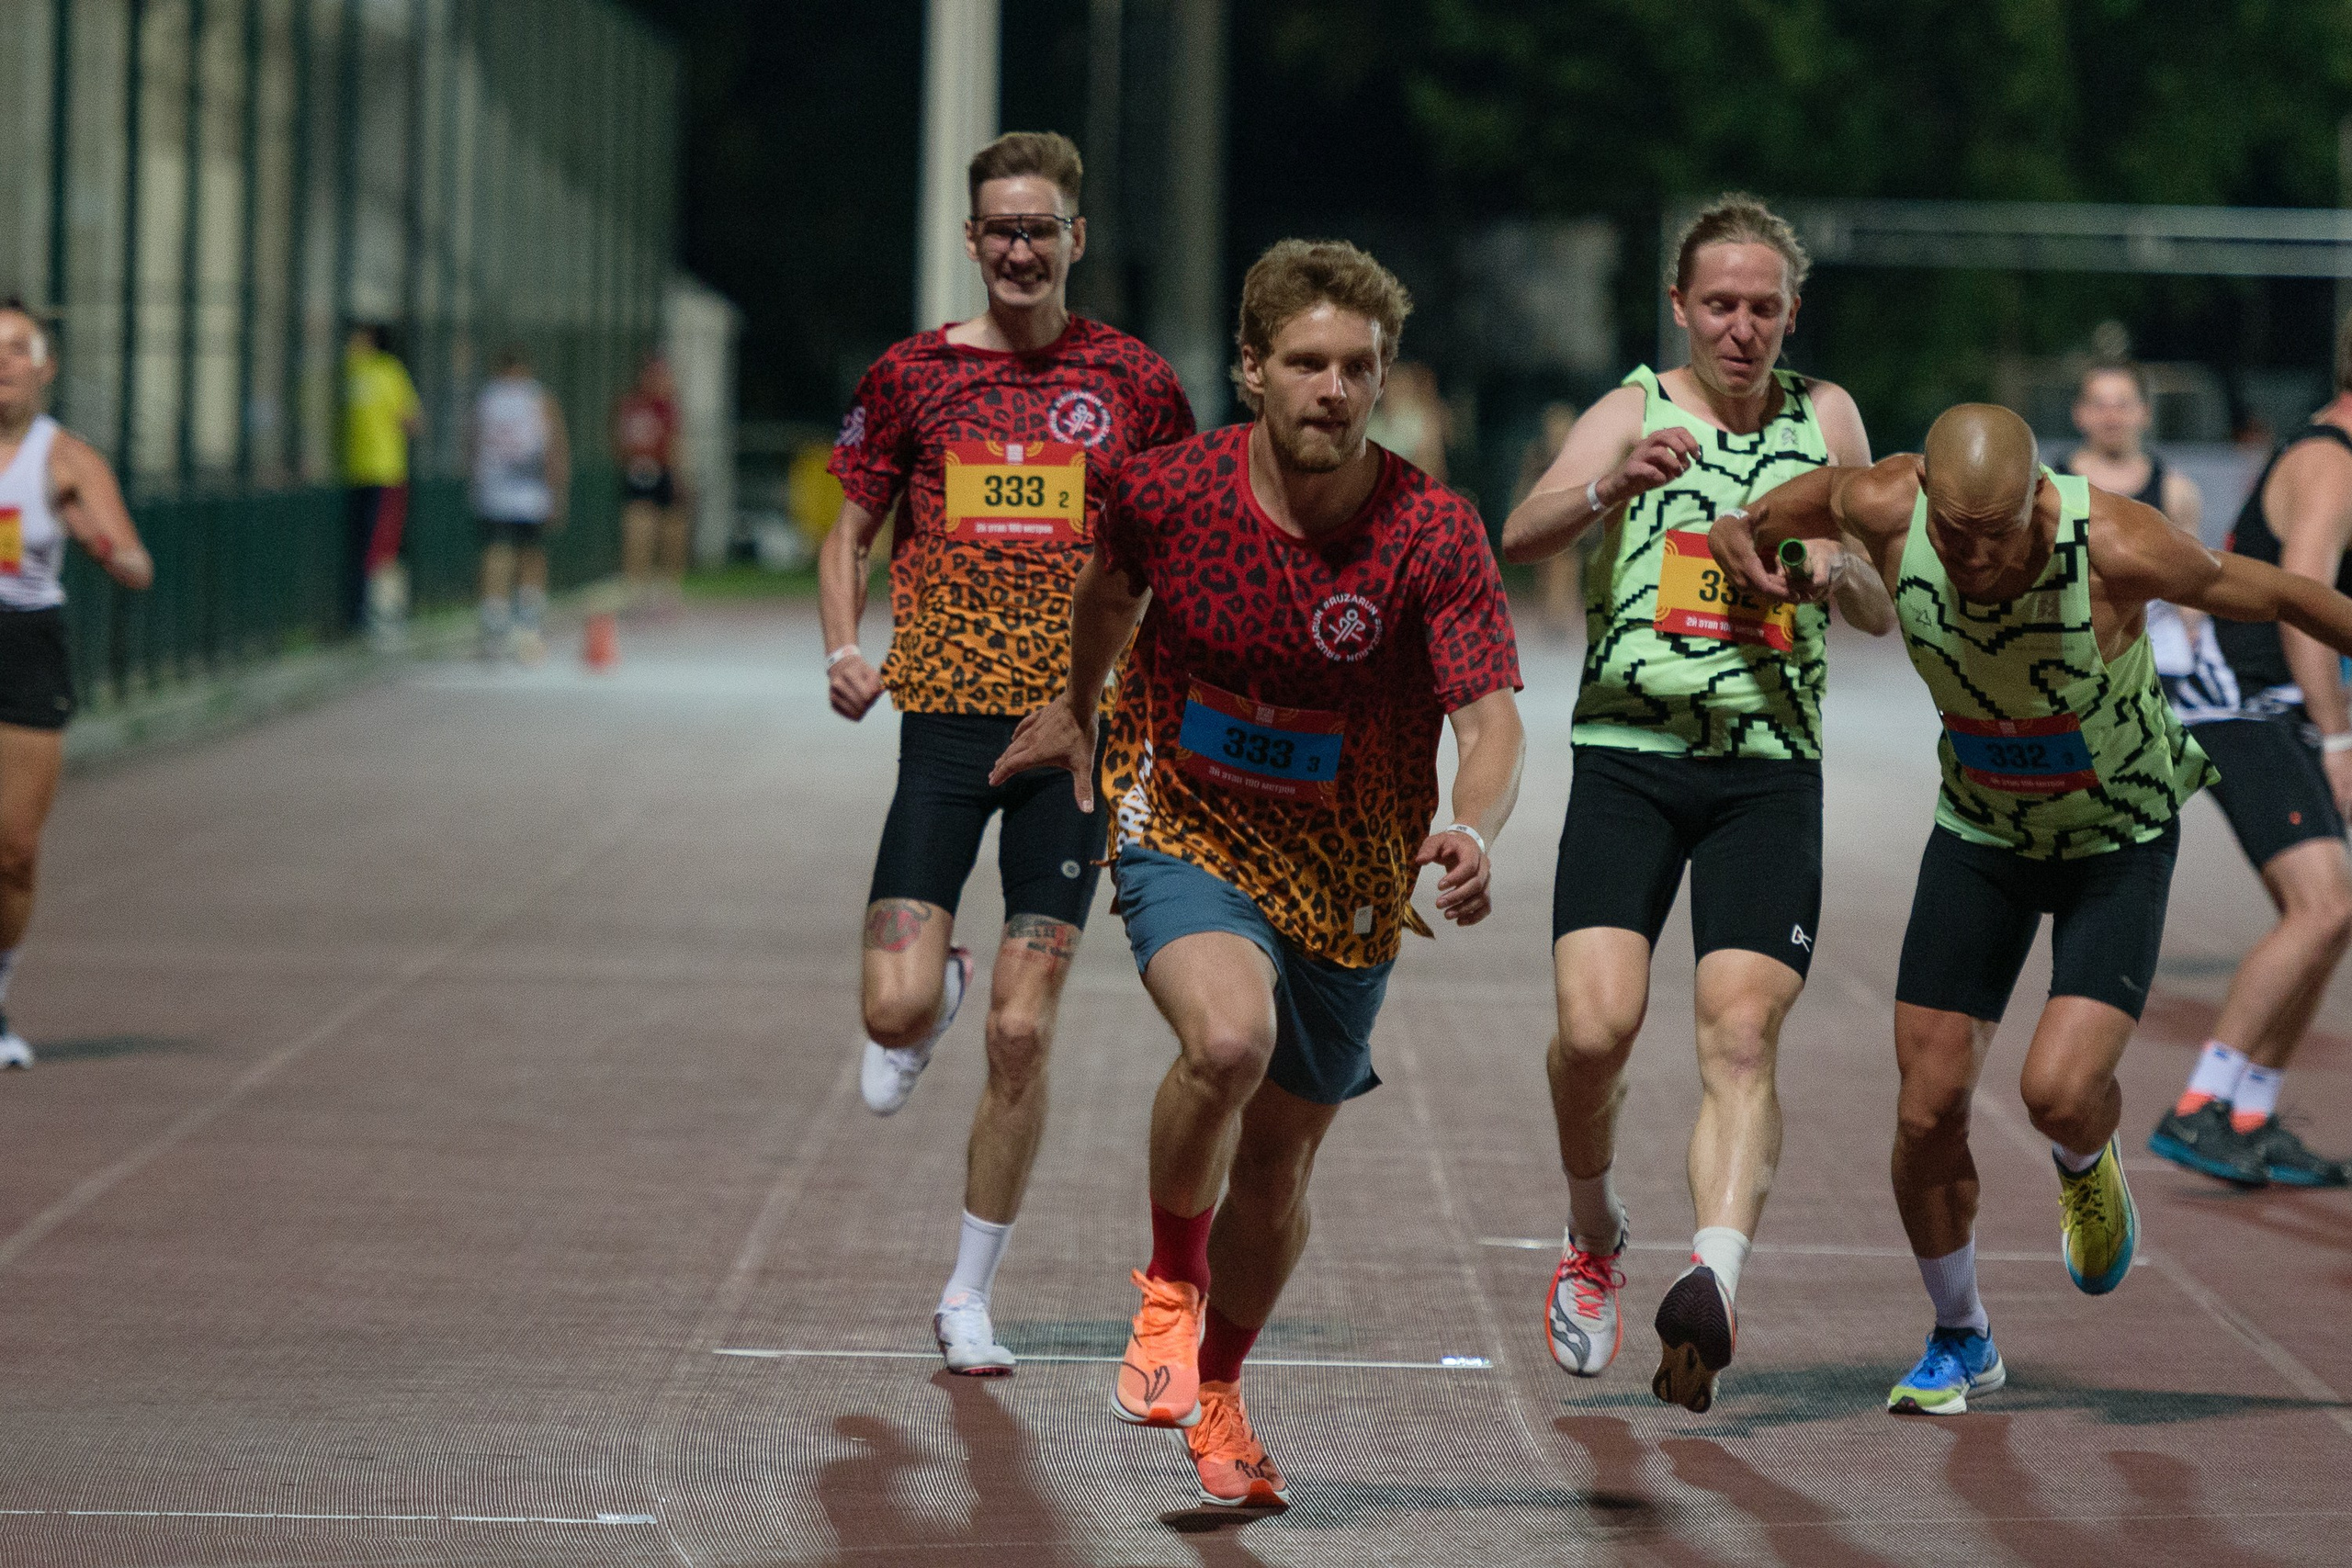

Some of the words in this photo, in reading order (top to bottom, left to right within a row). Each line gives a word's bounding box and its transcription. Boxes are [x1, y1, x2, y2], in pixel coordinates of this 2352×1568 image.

[984, 475, 1046, 507] 333
[1058, 491, 1069, 508] 2
[1222, 727, 1295, 769] 333
[1306, 755, 1321, 773] 3
[1986, 743, 2051, 768] 332
[2062, 751, 2075, 766] 3
